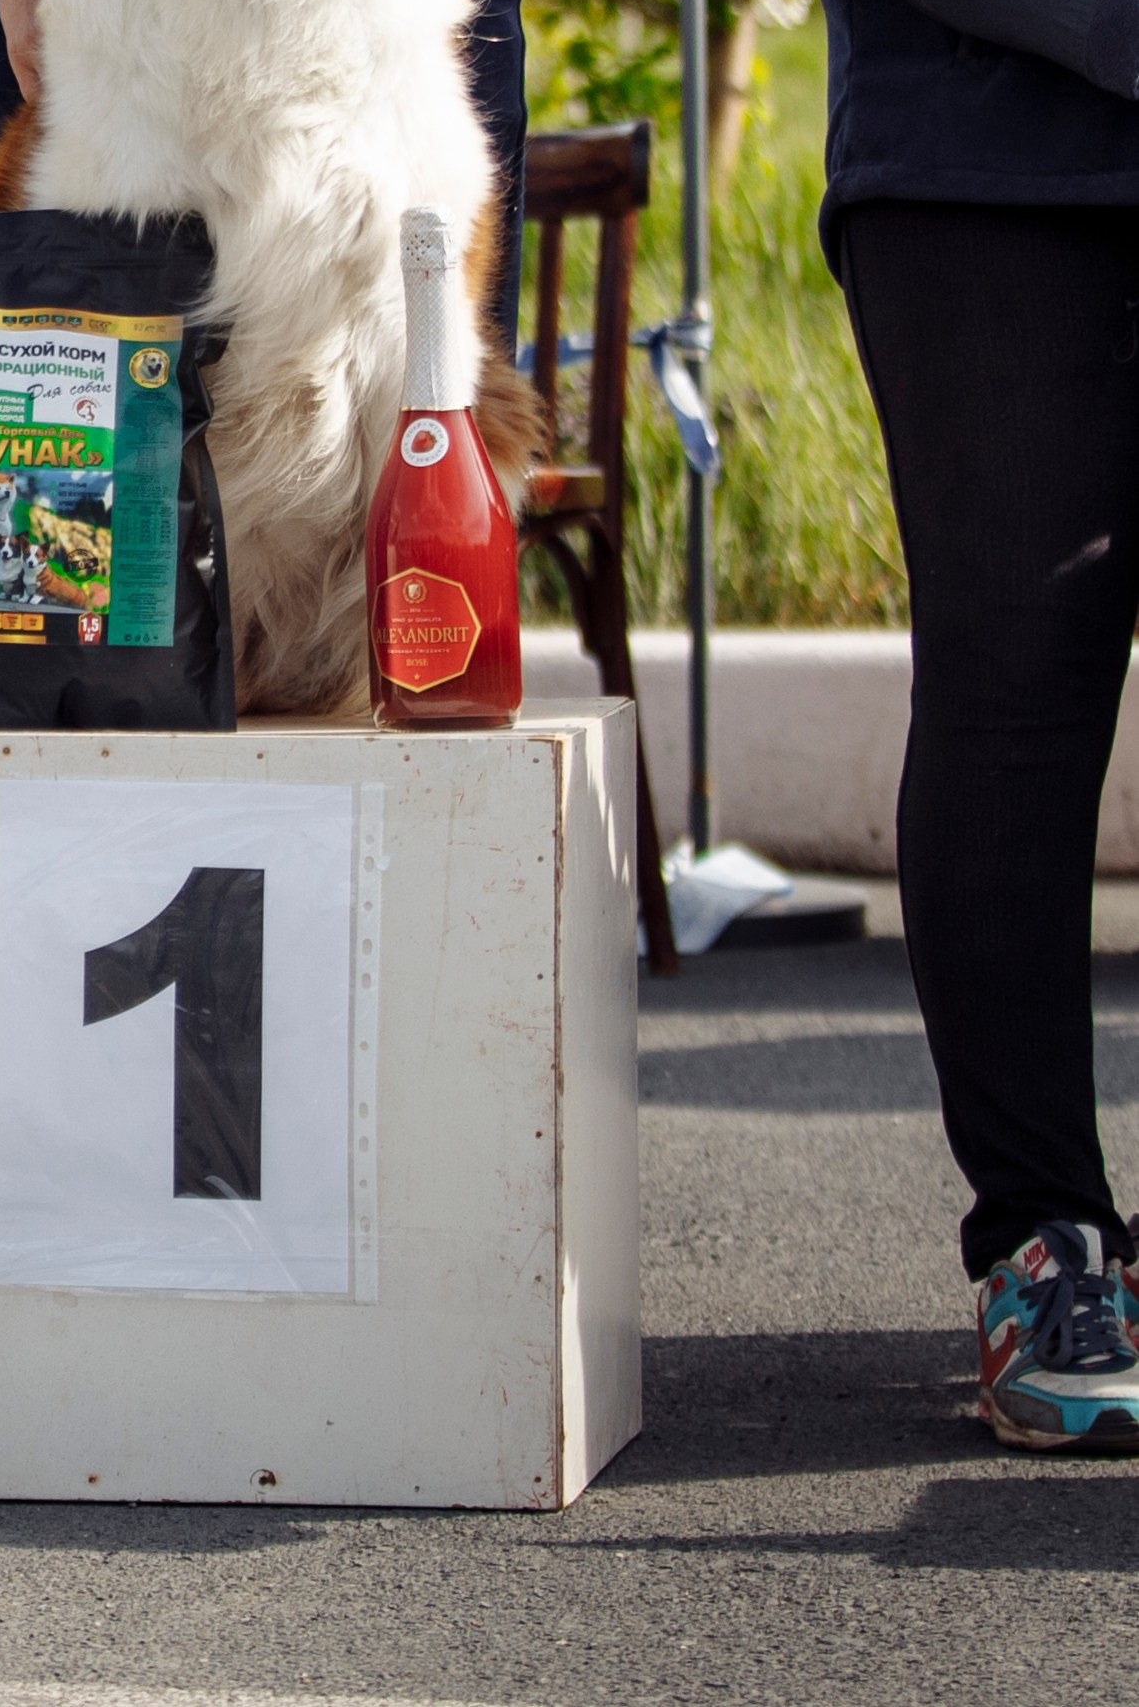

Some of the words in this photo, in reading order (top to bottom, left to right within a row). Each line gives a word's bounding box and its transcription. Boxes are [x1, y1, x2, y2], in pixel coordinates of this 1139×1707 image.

[58, 346, 106, 364] КОРМ
[27, 383, 62, 401] Для
[70, 381, 112, 395] собак
[81, 617, 99, 634] 1,5
[83, 866, 265, 1200] 1
